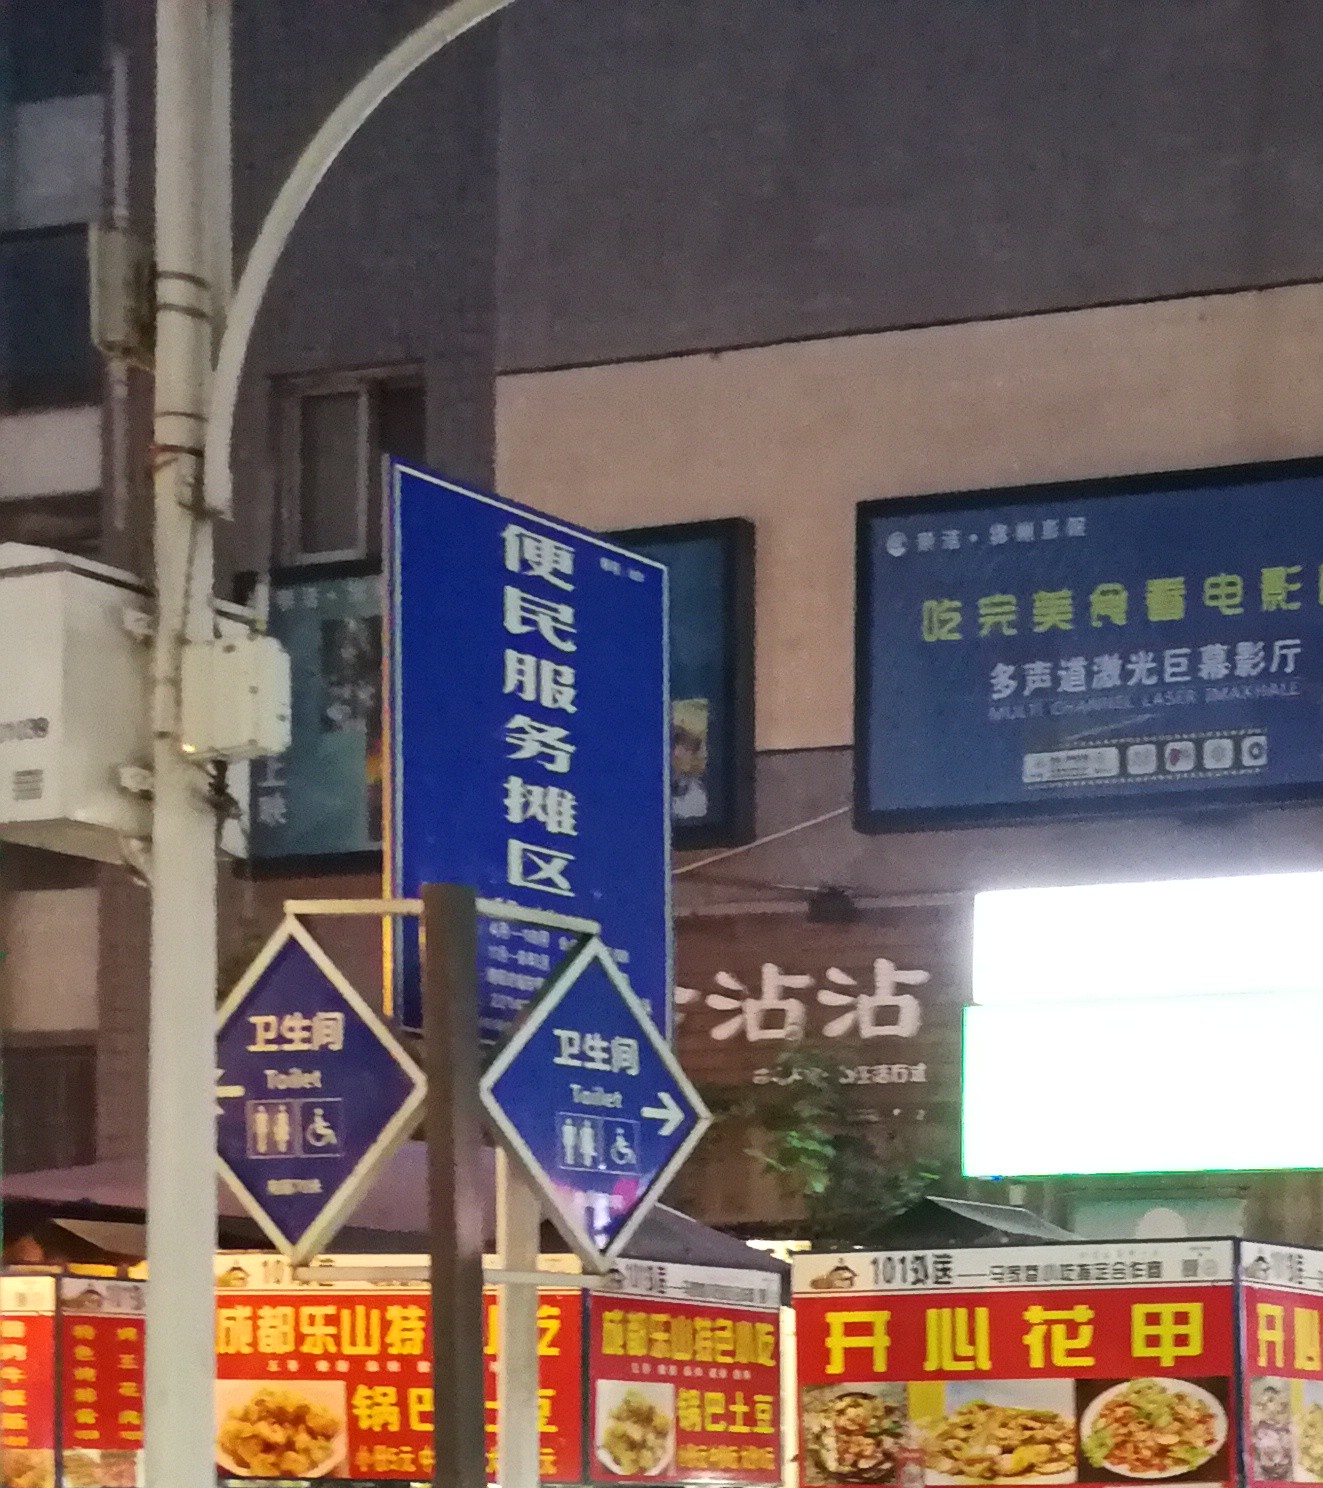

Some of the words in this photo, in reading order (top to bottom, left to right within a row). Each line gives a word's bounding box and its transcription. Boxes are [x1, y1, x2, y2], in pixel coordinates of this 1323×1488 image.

[990, 639, 1300, 700] 多声道激光巨幕影厅
[502, 523, 578, 897] 便民服务摊区
[675, 957, 931, 1042] 沾沾
[246, 1012, 345, 1051] 卫生间
[553, 1028, 640, 1075] 卫生间
[602, 1309, 777, 1367] 成都乐山特色小吃
[825, 1303, 1204, 1375] 开心花甲
[677, 1387, 775, 1433] 锅巴土豆
